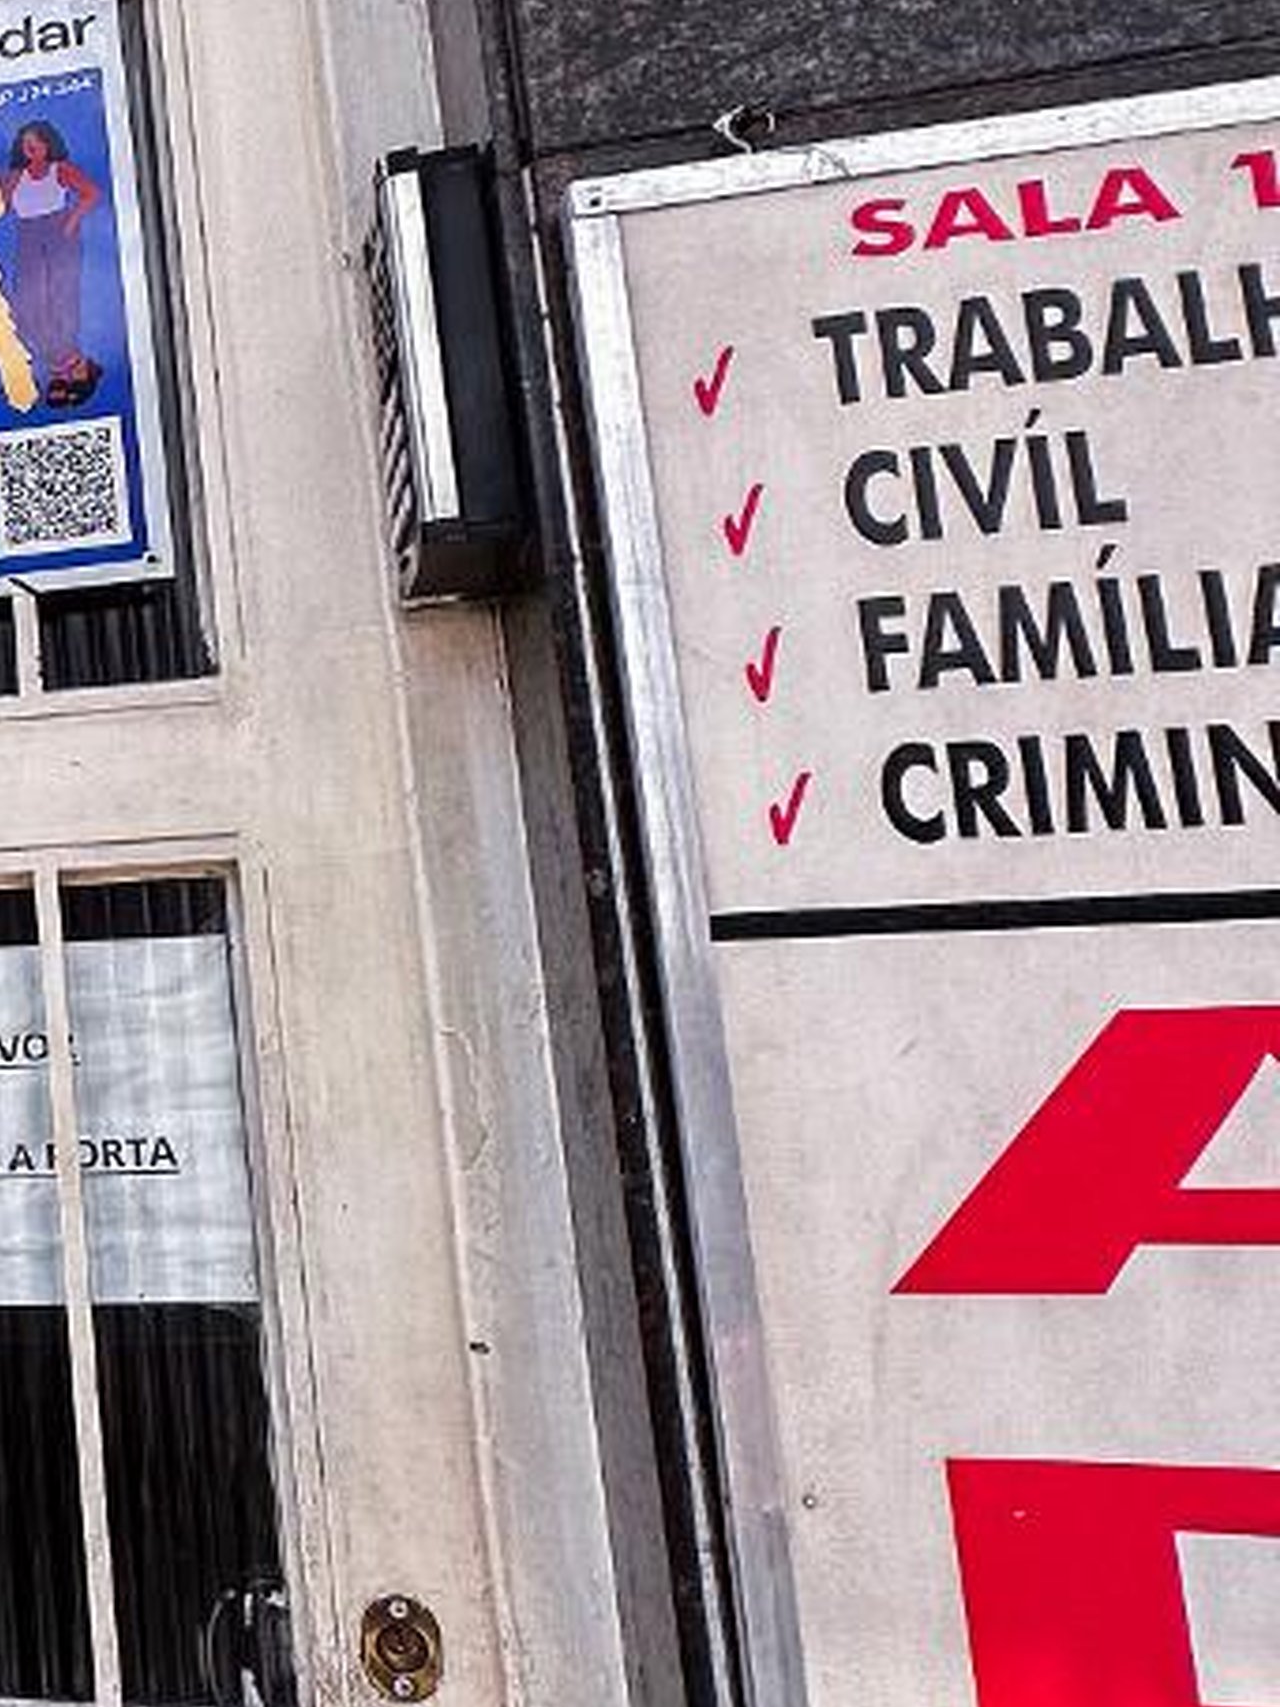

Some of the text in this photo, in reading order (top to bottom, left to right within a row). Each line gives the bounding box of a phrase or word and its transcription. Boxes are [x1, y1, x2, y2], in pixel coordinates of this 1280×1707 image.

[850, 166, 1181, 259] SALA
[843, 408, 1128, 547] CIVÍL
[9, 1144, 35, 1172] A
